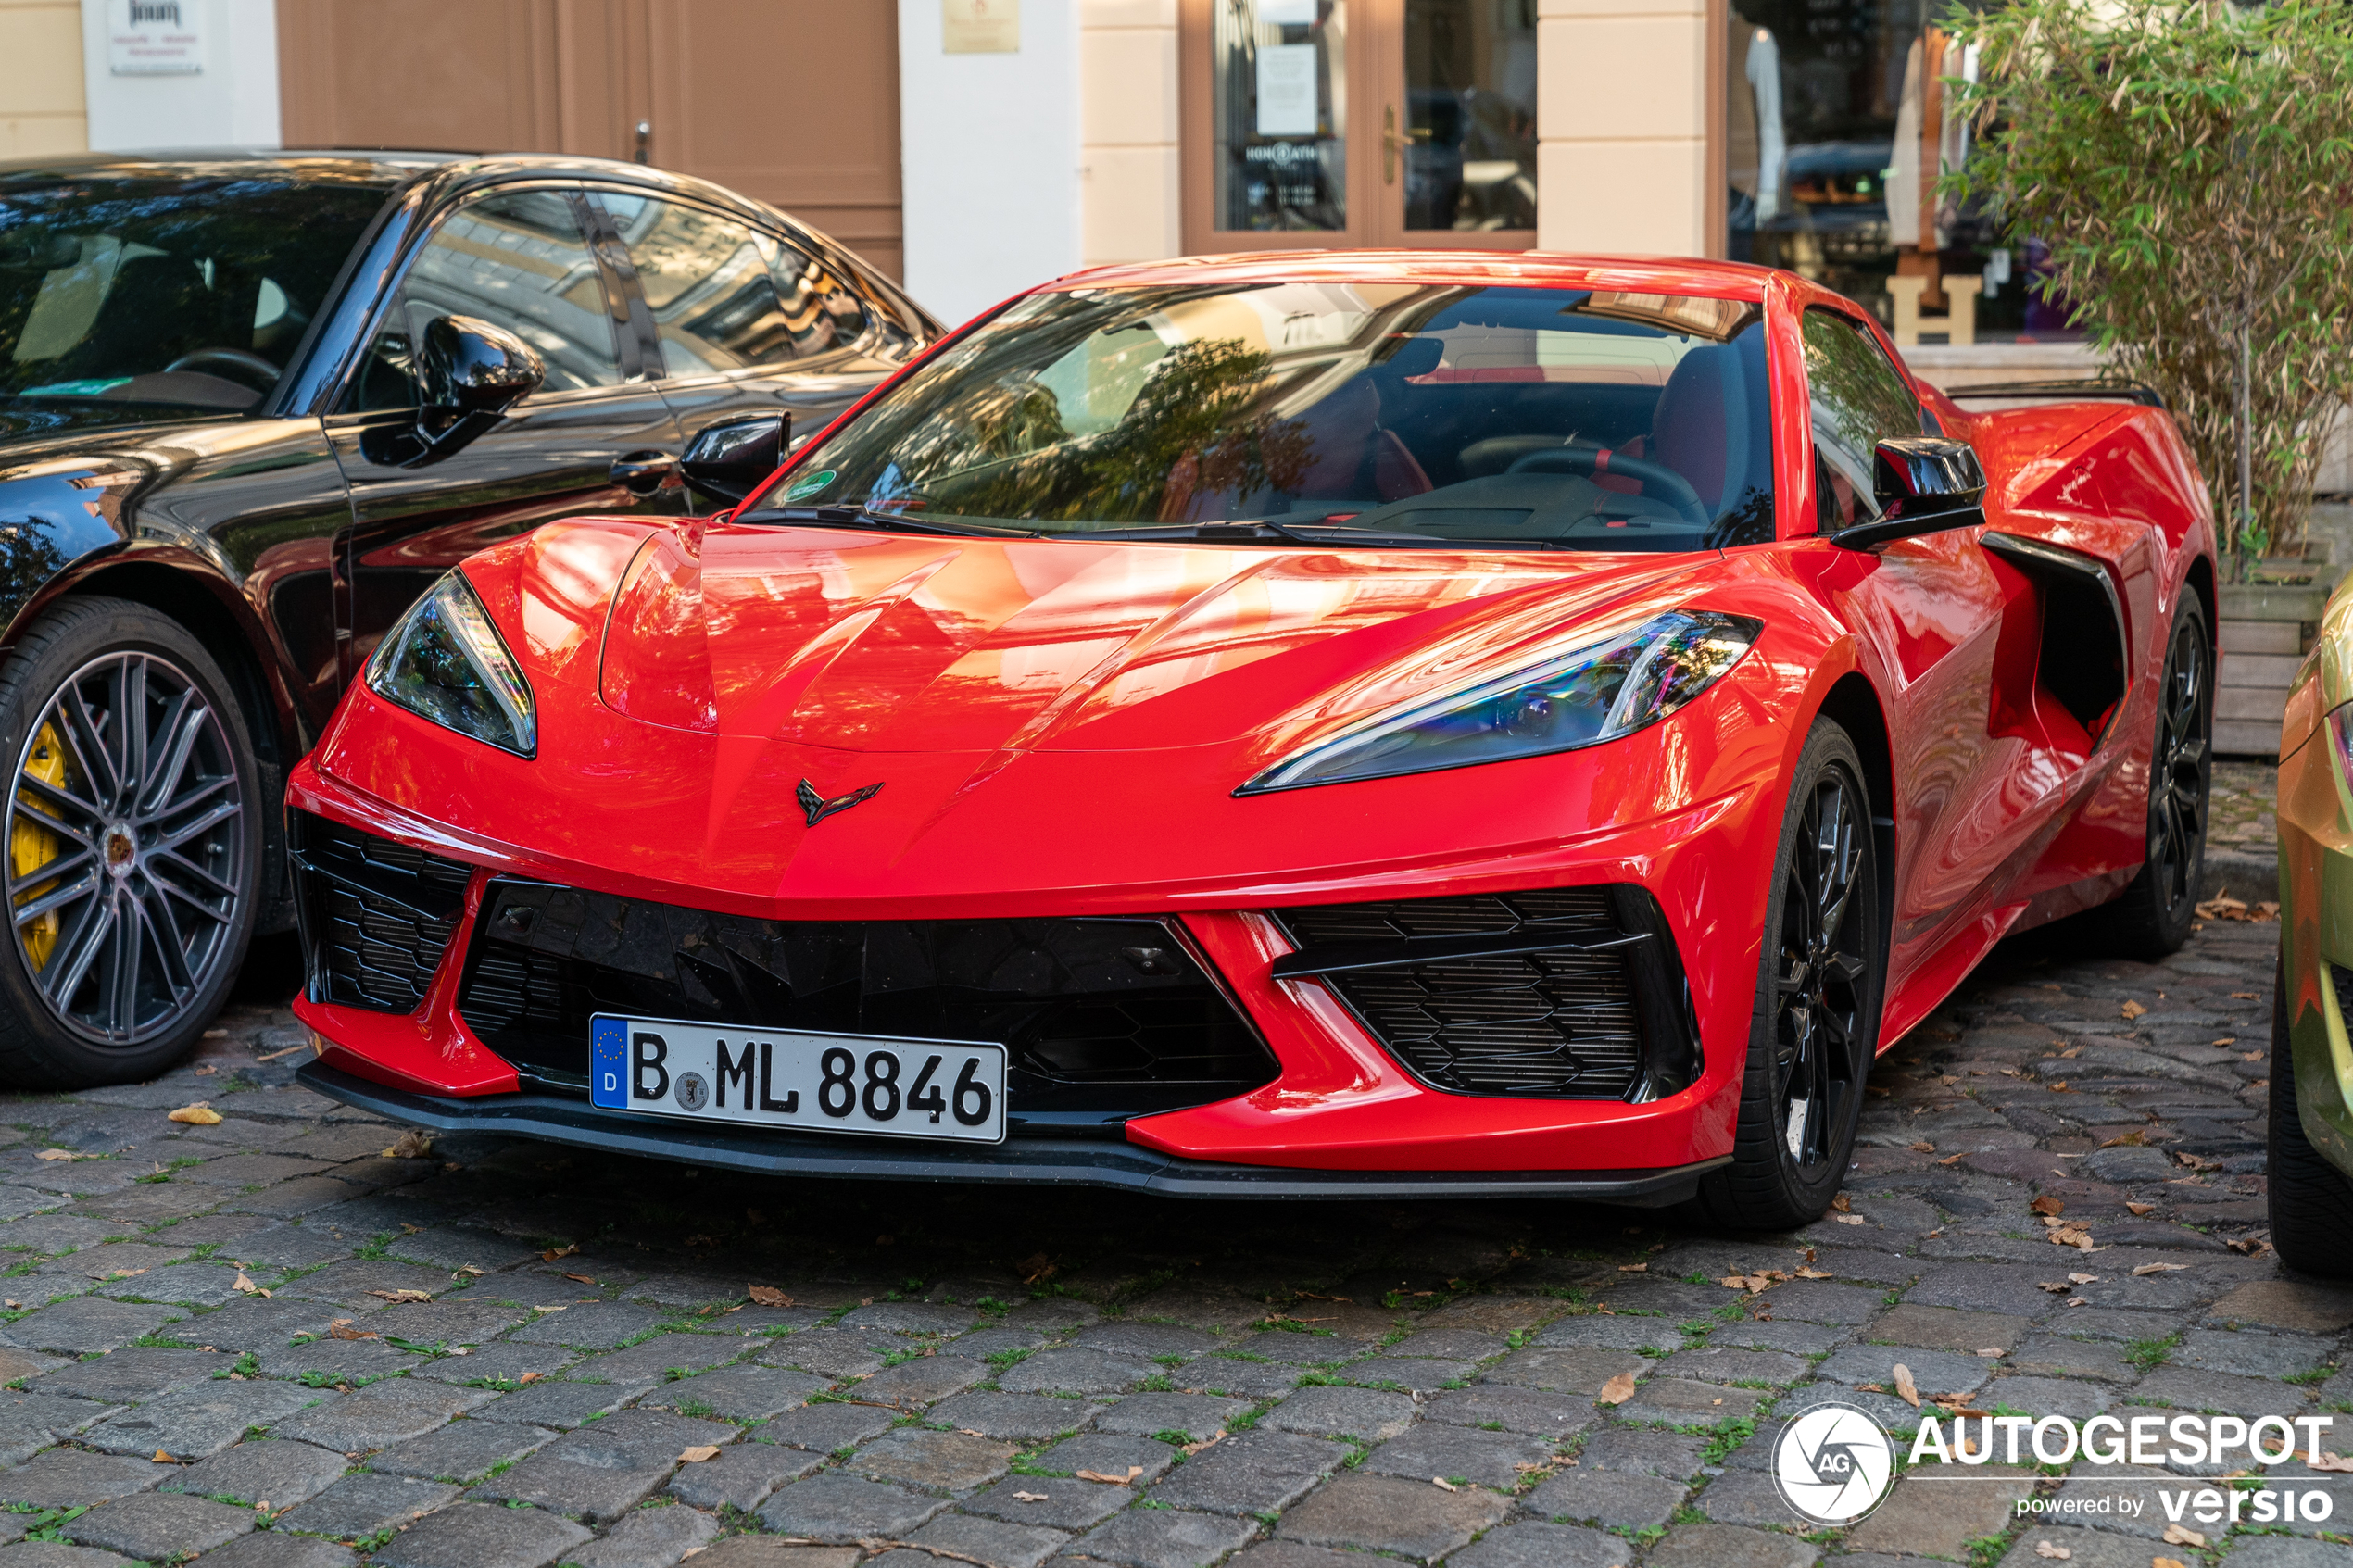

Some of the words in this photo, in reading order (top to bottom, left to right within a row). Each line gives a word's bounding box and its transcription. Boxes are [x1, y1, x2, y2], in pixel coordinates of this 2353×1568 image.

[604, 1073, 617, 1092] D
[633, 1031, 670, 1101] B
[715, 1038, 799, 1114] ML
[818, 1047, 993, 1126] 8846
